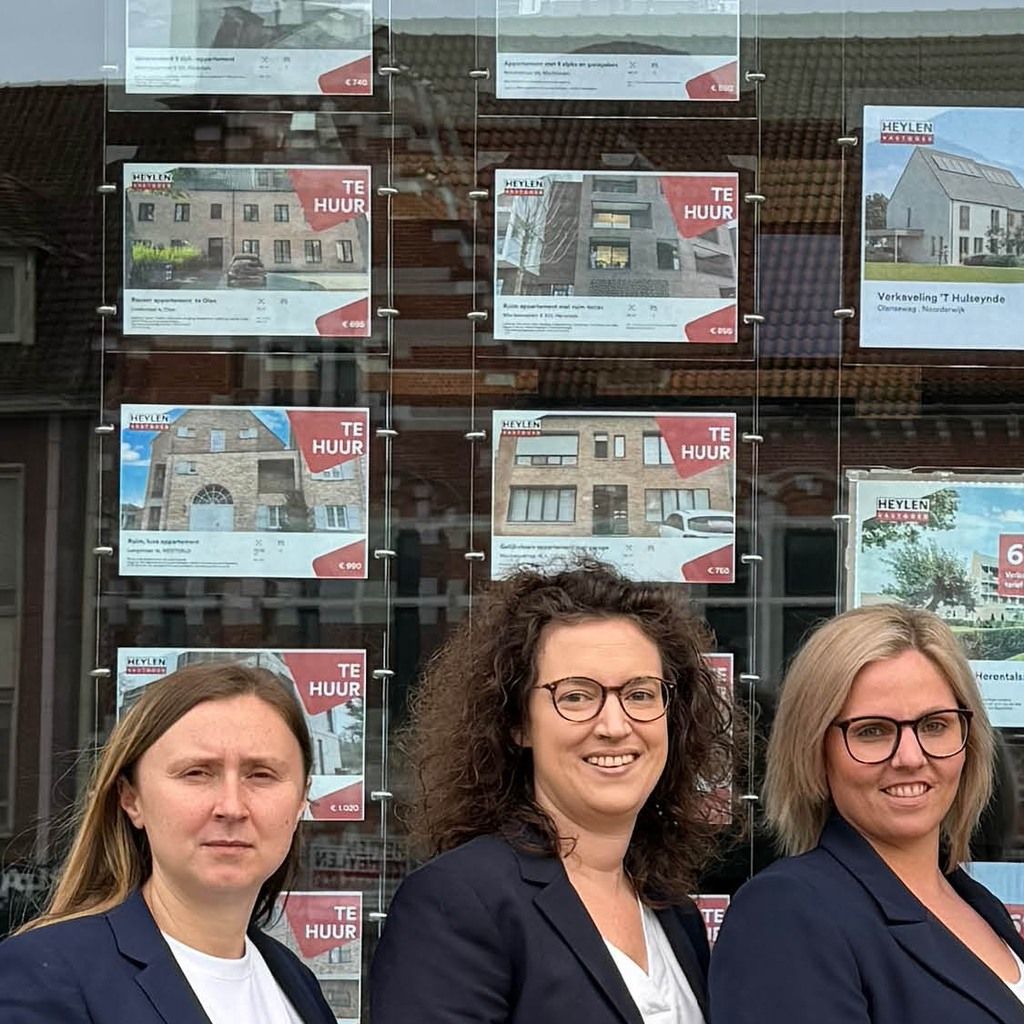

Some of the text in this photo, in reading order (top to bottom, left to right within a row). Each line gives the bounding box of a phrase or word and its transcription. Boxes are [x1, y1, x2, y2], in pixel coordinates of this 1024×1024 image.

[881, 121, 933, 133] HEYLEN
[132, 173, 172, 182] HEYLEN
[505, 180, 544, 188] HEYLEN
[341, 180, 365, 195] TE
[710, 187, 733, 202] TE
[313, 198, 366, 214] HUUR
[683, 204, 734, 220] HUUR
[877, 292, 938, 304] Verkaveling
[952, 294, 1006, 304] Hulseynde
[131, 414, 169, 422] HEYLEN
[503, 420, 541, 429] HEYLEN
[341, 421, 363, 436] TE
[708, 427, 731, 442] TE
[312, 440, 363, 455] HUUR
[681, 445, 731, 460] HUUR
[878, 499, 928, 510] HEYLEN
[127, 657, 166, 666] HEYLEN
[337, 663, 360, 678] TE
[309, 681, 361, 697] HUUR
[333, 906, 357, 921] TE
[702, 908, 725, 923] TE
[305, 924, 356, 939] HUUR
